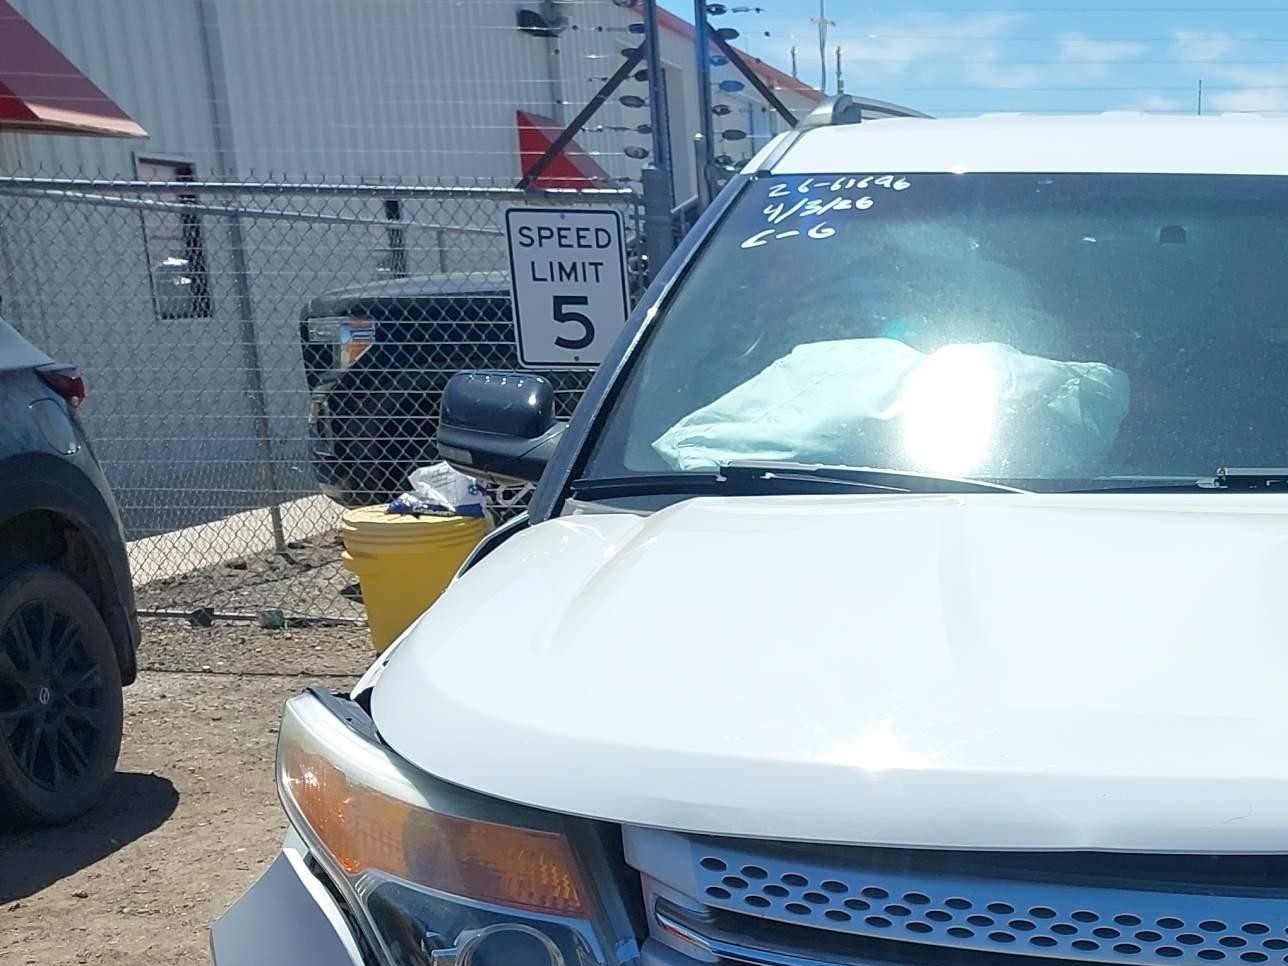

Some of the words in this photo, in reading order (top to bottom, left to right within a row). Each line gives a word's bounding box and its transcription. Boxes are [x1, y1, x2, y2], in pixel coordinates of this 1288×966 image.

[518, 226, 612, 249] SPEED
[530, 261, 604, 283] LIMIT
[552, 295, 595, 350] 5
